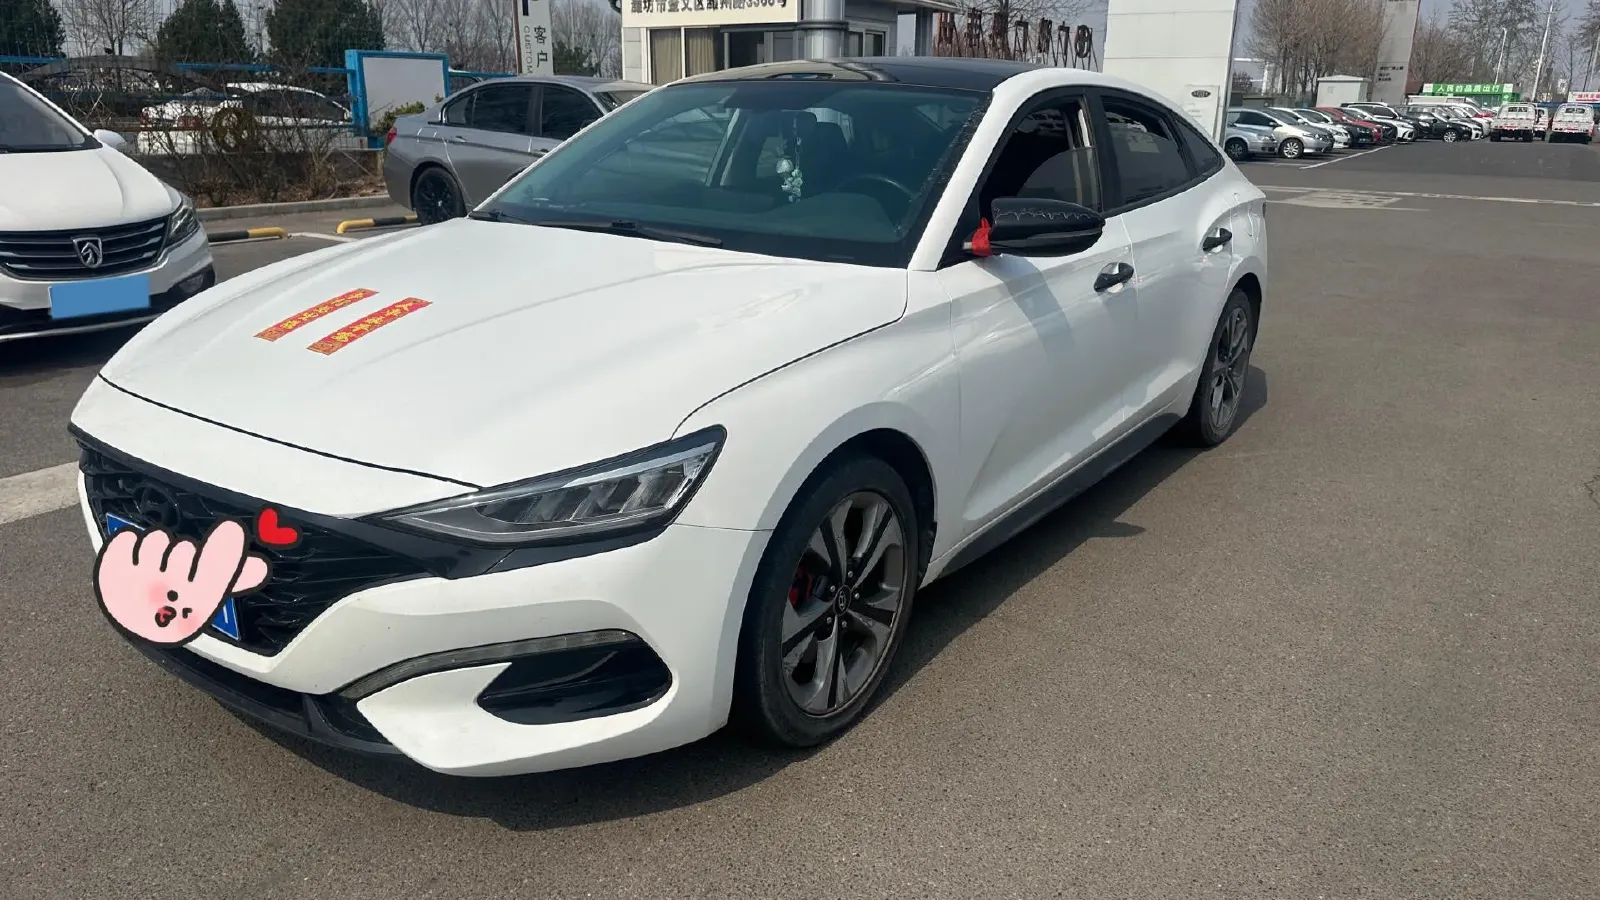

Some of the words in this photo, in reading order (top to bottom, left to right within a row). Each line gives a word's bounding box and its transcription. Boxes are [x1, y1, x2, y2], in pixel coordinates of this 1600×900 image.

[533, 25, 548, 68] 客户
[1437, 84, 1500, 93] 人民的品质出行
